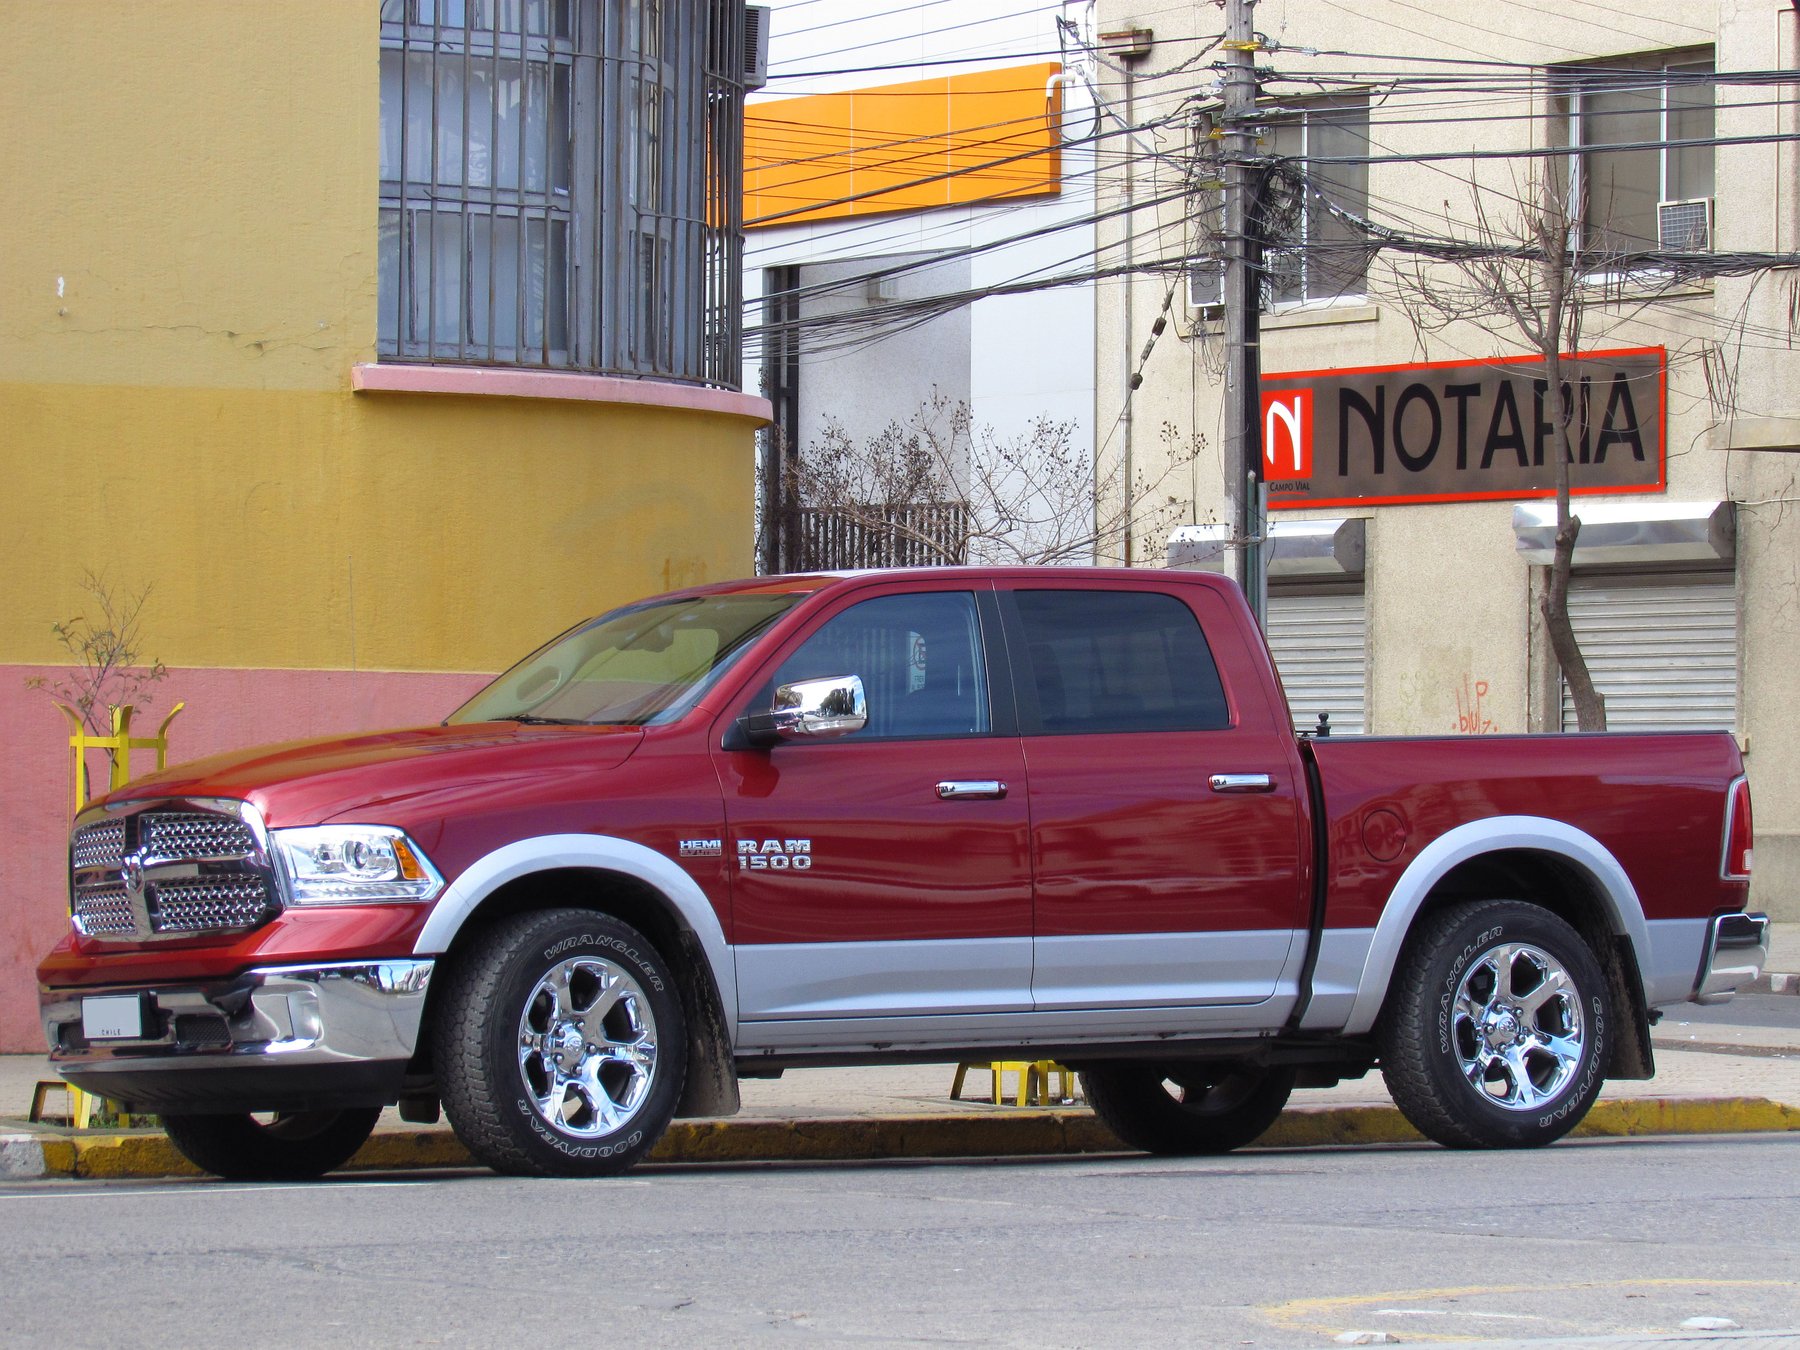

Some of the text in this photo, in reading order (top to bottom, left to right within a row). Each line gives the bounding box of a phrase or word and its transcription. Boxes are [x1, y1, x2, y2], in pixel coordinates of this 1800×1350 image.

[1338, 372, 1645, 476] NOTARIA
[679, 839, 722, 849] HEMI
[737, 839, 811, 854] RAM
[737, 855, 812, 870] 1500
[544, 934, 665, 993] WRANGLER
[1437, 926, 1504, 1054] WRANGLER
[101, 1028, 121, 1037] CHILE
[1539, 996, 1605, 1128] GOODYEAR
[517, 1098, 643, 1158] GOODYEAR
